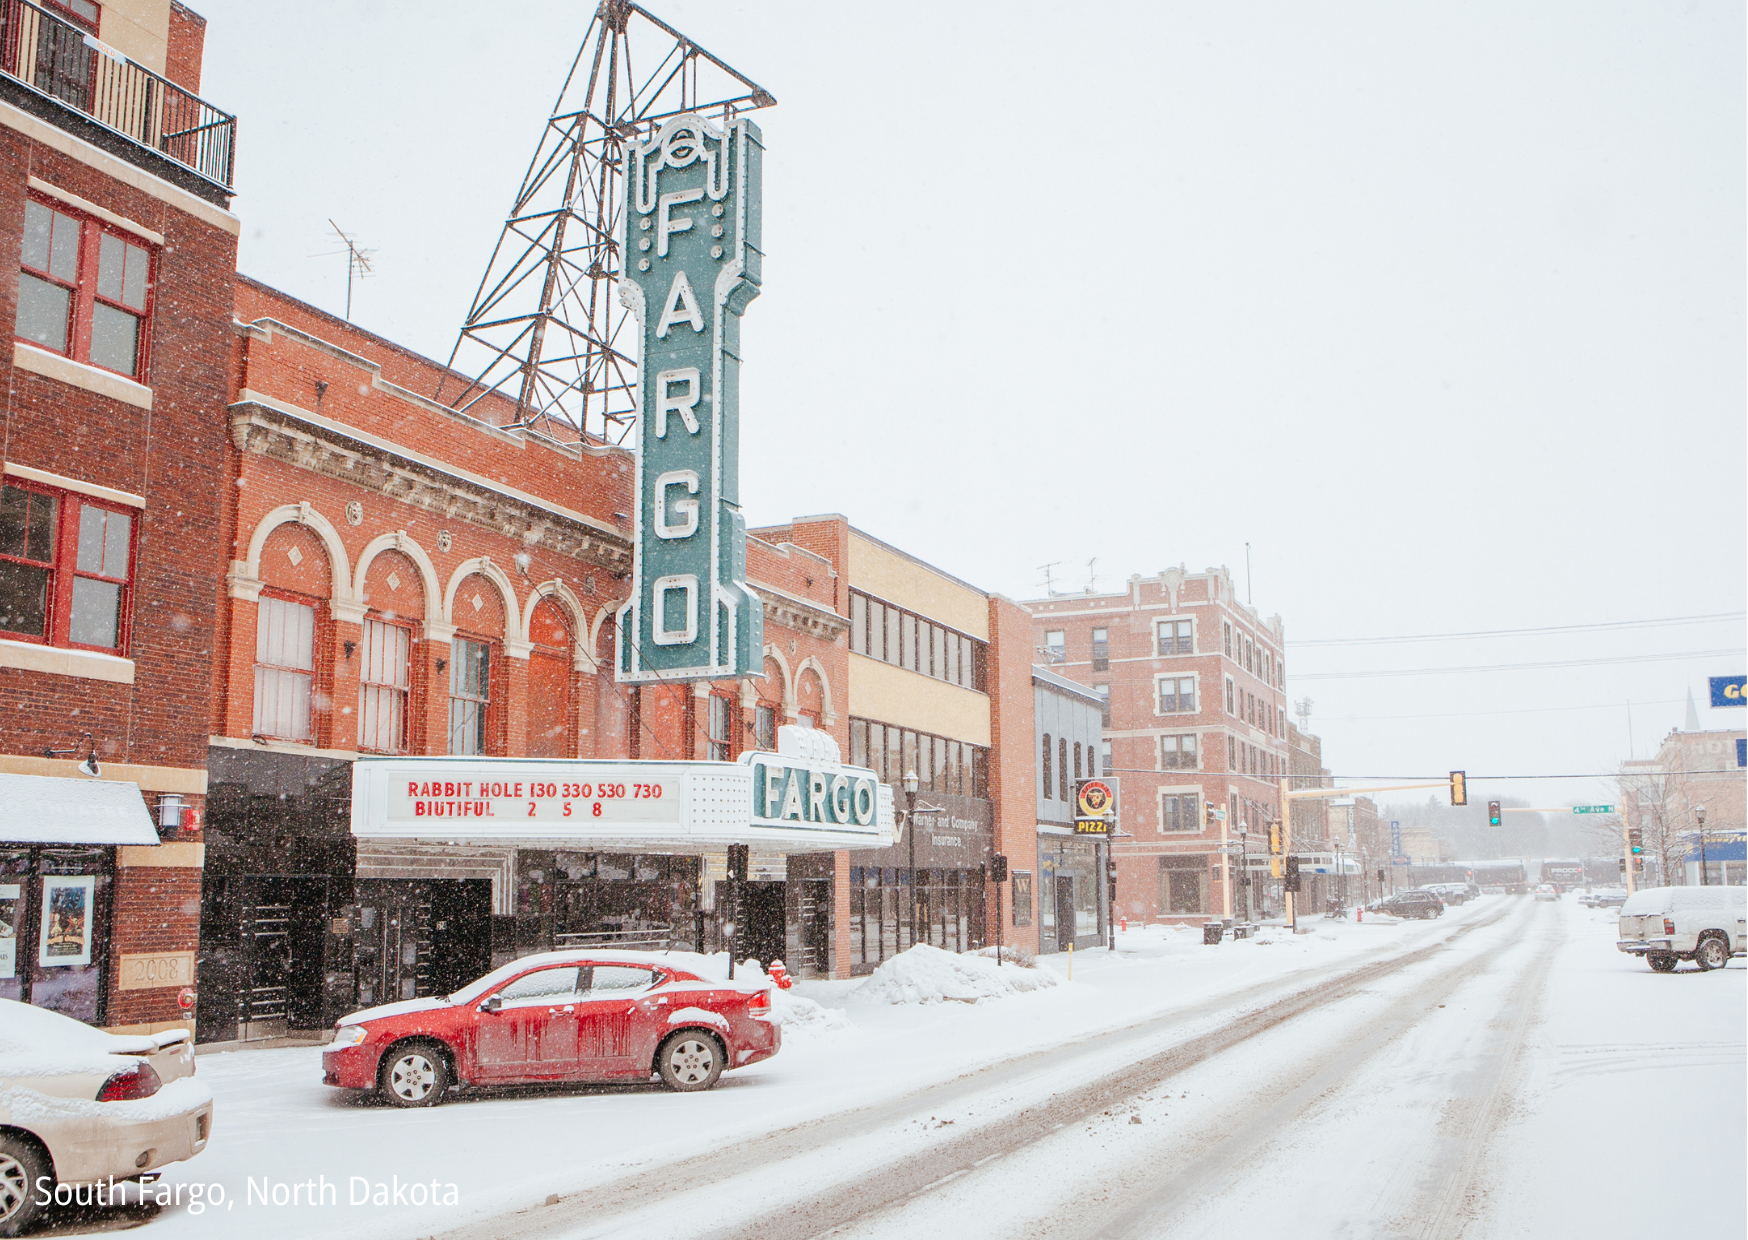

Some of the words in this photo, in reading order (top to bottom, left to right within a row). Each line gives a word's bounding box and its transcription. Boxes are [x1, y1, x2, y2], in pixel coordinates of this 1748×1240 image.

[96, 43, 116, 57] SOLD
[652, 187, 705, 646] FARGO
[408, 781, 473, 797] RABBIT
[480, 782, 523, 797] HOLE
[562, 783, 593, 798] 330
[597, 783, 627, 798] 530
[633, 783, 663, 798] 730
[765, 764, 874, 825] FARGO
[415, 801, 494, 817] BIUTIFUL
[527, 801, 537, 817] 2
[562, 801, 572, 817] 5
[592, 801, 602, 817] 8
[1589, 805, 1605, 813] Ave
[1608, 805, 1614, 813] N
[913, 812, 936, 827] Warner
[937, 815, 950, 828] and
[951, 815, 978, 833] Company
[932, 833, 962, 847] Insurance
[1015, 878, 1030, 893] W
[134, 958, 179, 982] 2008
